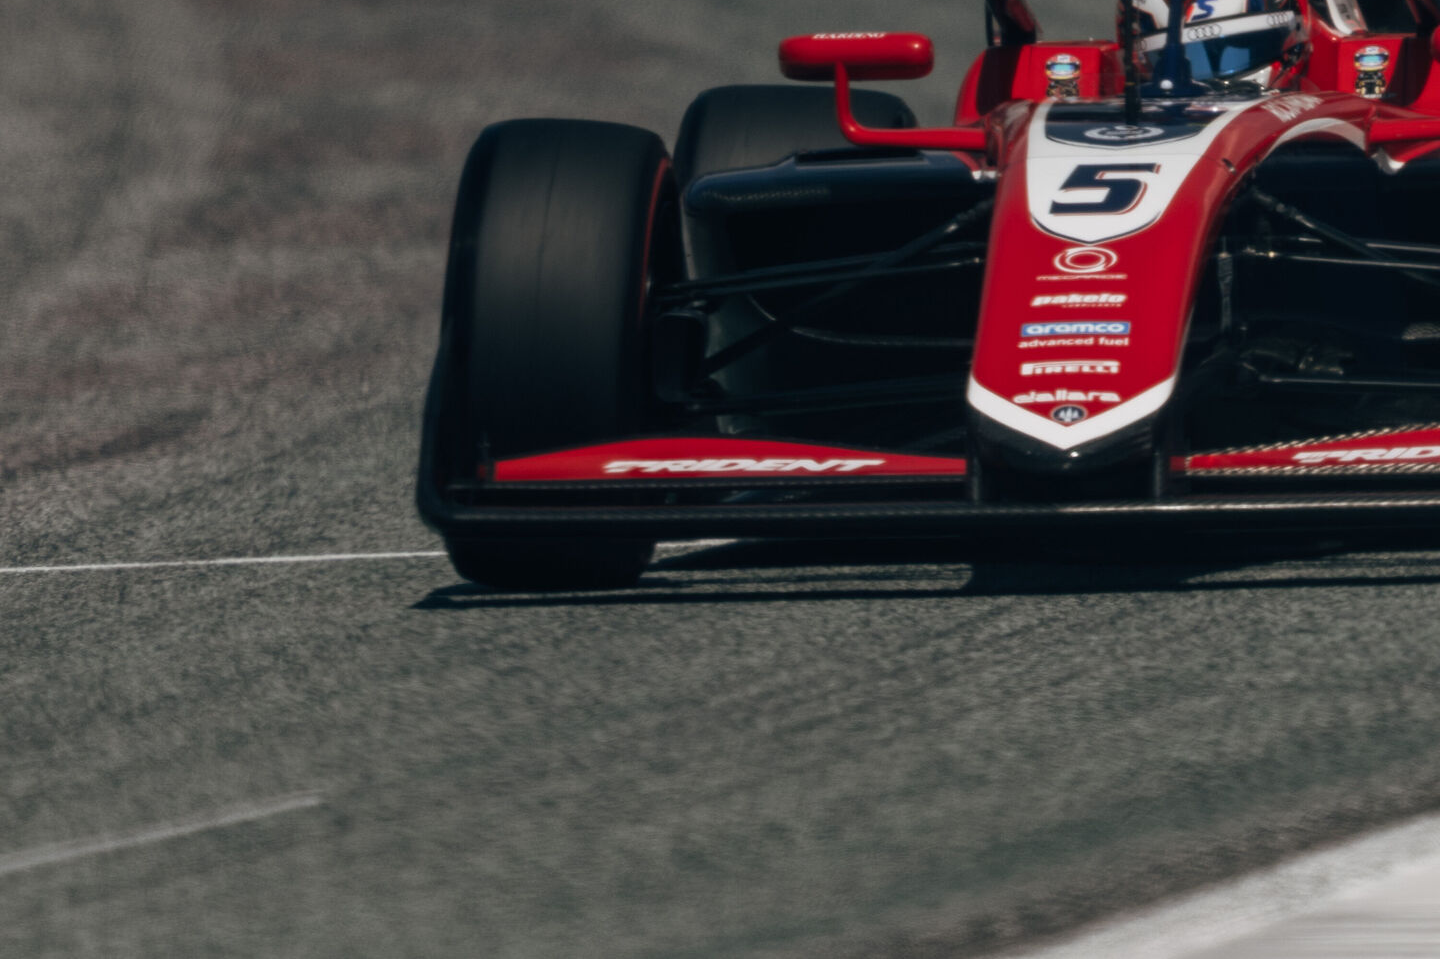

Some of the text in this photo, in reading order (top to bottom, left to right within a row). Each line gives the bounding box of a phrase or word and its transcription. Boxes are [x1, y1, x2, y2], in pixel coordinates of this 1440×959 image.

[1049, 162, 1161, 216] 5
[1026, 323, 1125, 335] aramco
[1018, 337, 1129, 348] advanced fuel
[1020, 360, 1120, 376] PIRELLI
[1013, 389, 1121, 404] dallara
[602, 458, 886, 473] TRIDENT
